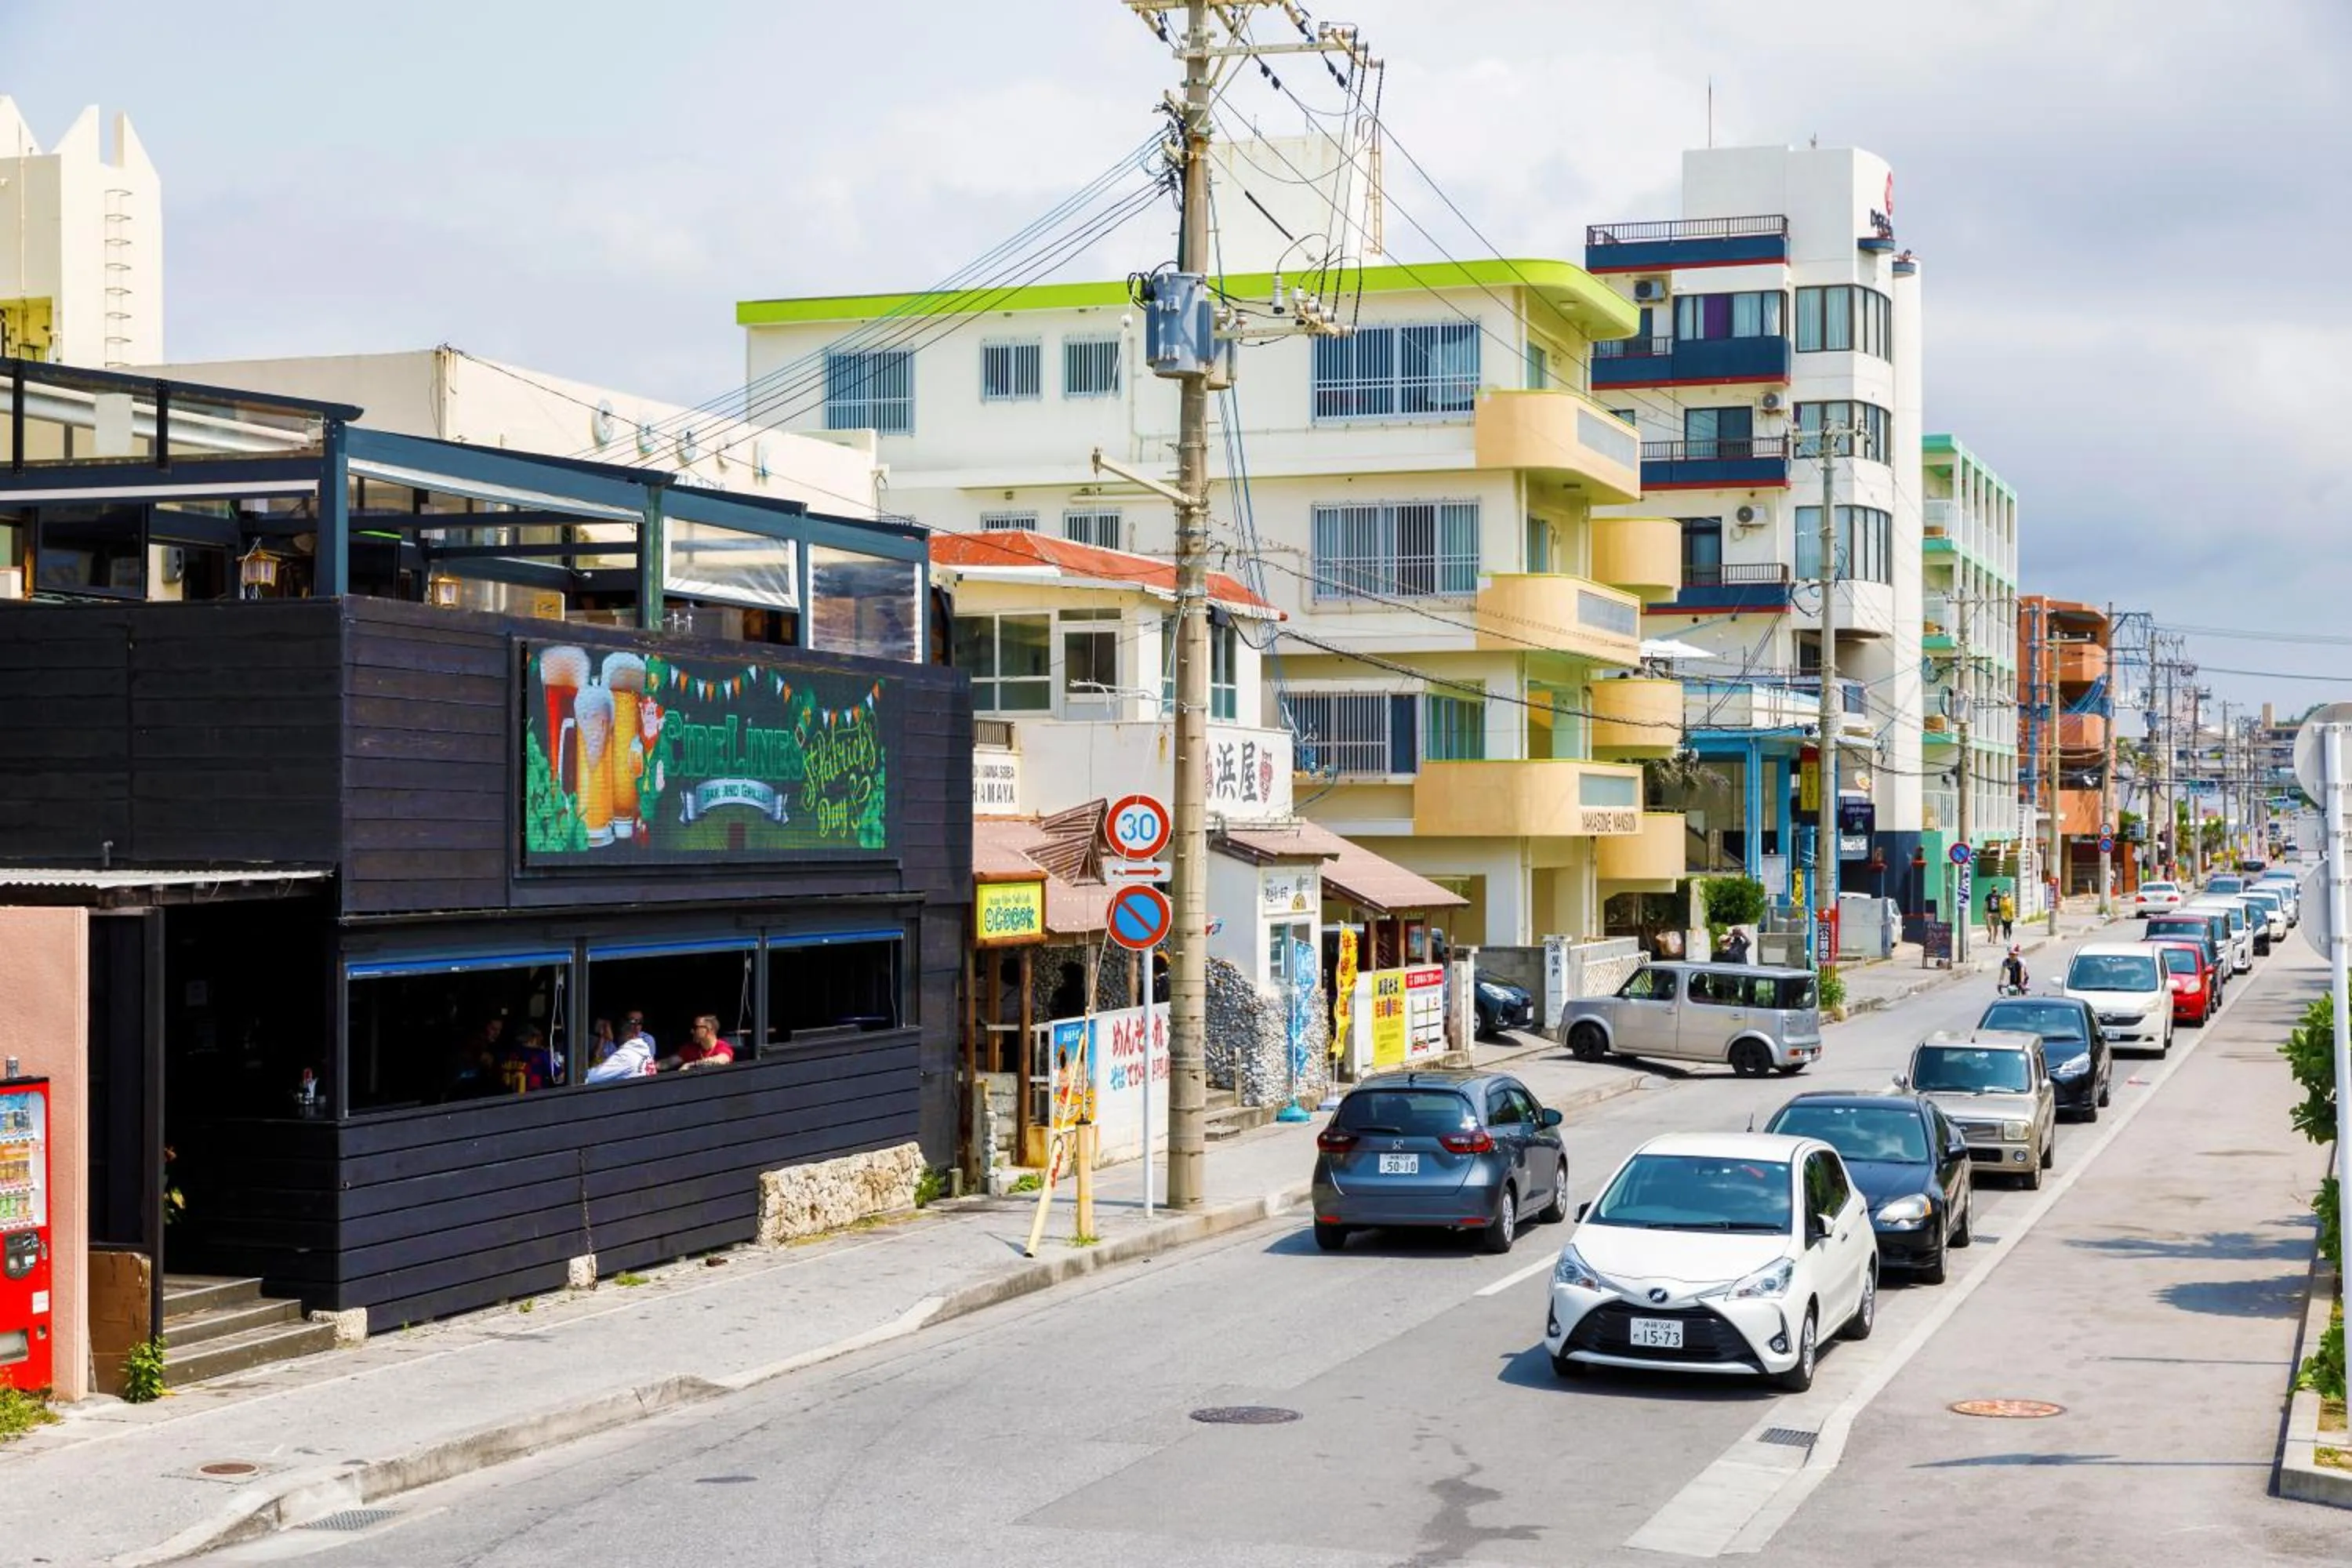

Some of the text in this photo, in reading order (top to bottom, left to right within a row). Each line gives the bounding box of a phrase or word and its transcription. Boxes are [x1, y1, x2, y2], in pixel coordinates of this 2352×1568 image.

[1216, 741, 1258, 801] 浜屋
[1120, 813, 1156, 841] 30
[1112, 1013, 1163, 1058] めんそれ
[1643, 1329, 1681, 1347] 15-73
